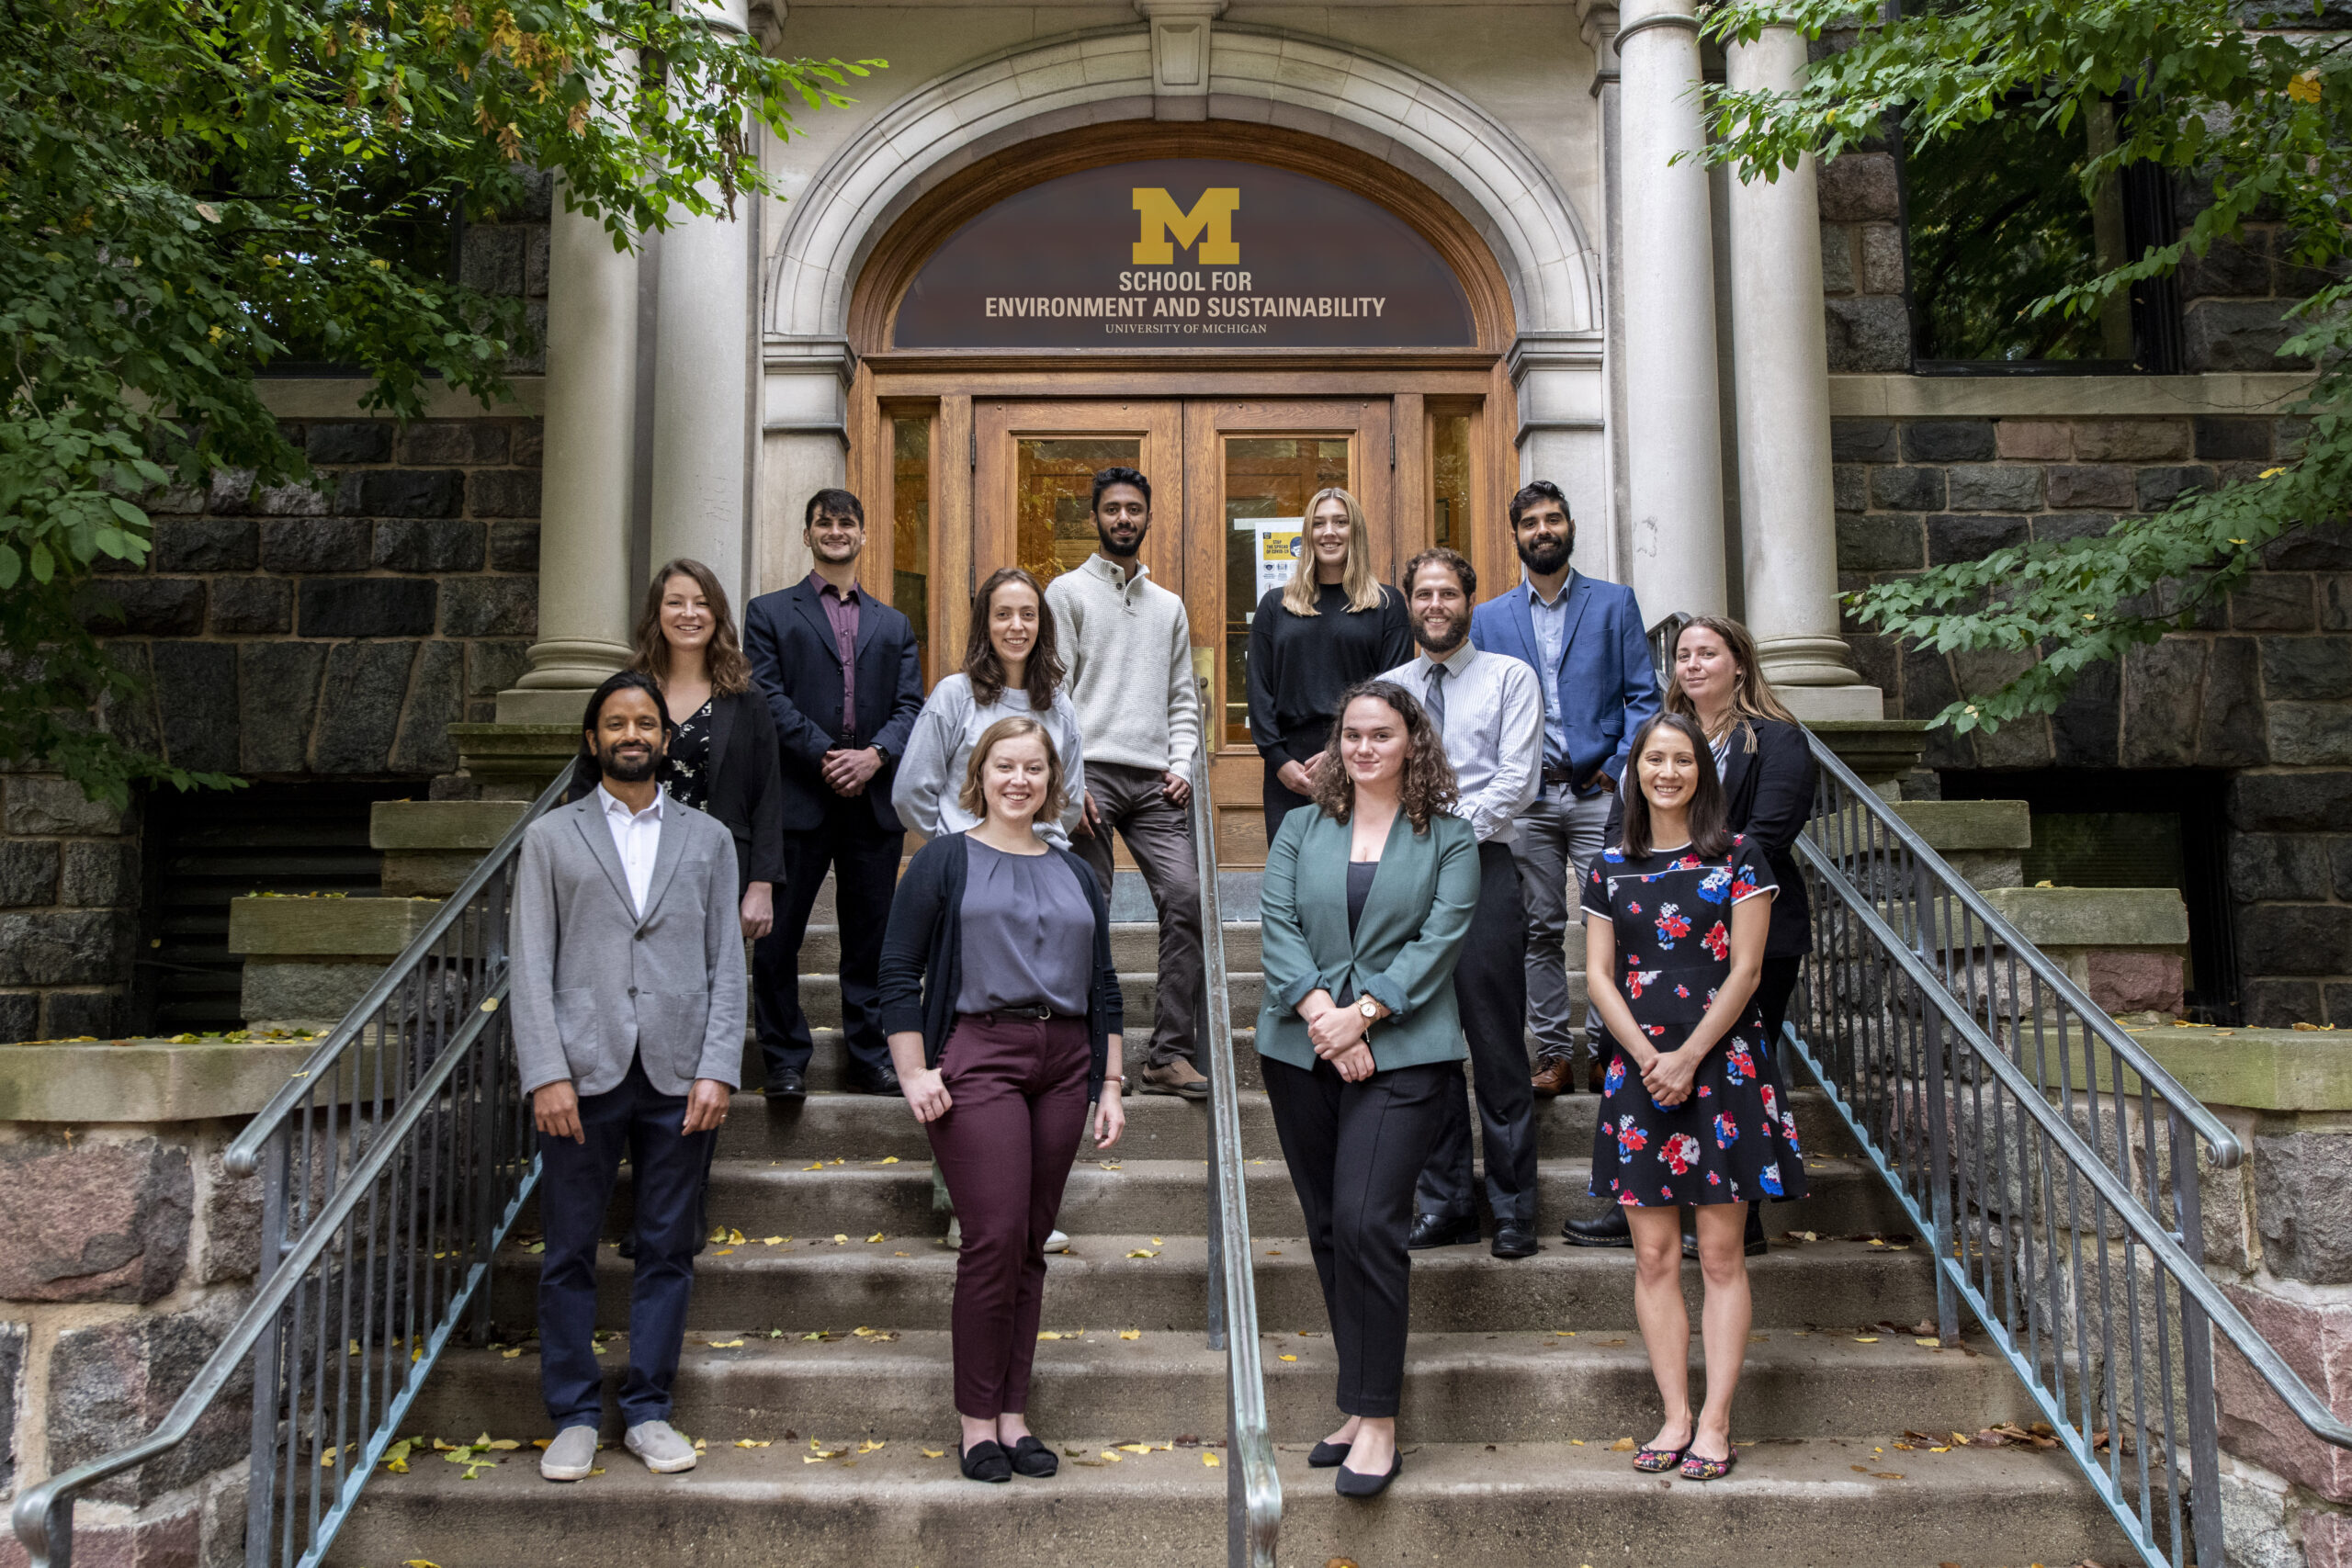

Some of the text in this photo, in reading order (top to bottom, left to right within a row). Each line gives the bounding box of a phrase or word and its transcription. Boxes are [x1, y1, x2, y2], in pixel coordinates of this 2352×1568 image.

[1132, 187, 1240, 265] M
[1119, 271, 1252, 292] SCHOOL FOR
[985, 297, 1386, 318] ENVIRONMENT AND SUSTAINABILITY
[1105, 323, 1268, 333] UNIVERSITY OF MICHIGAN
